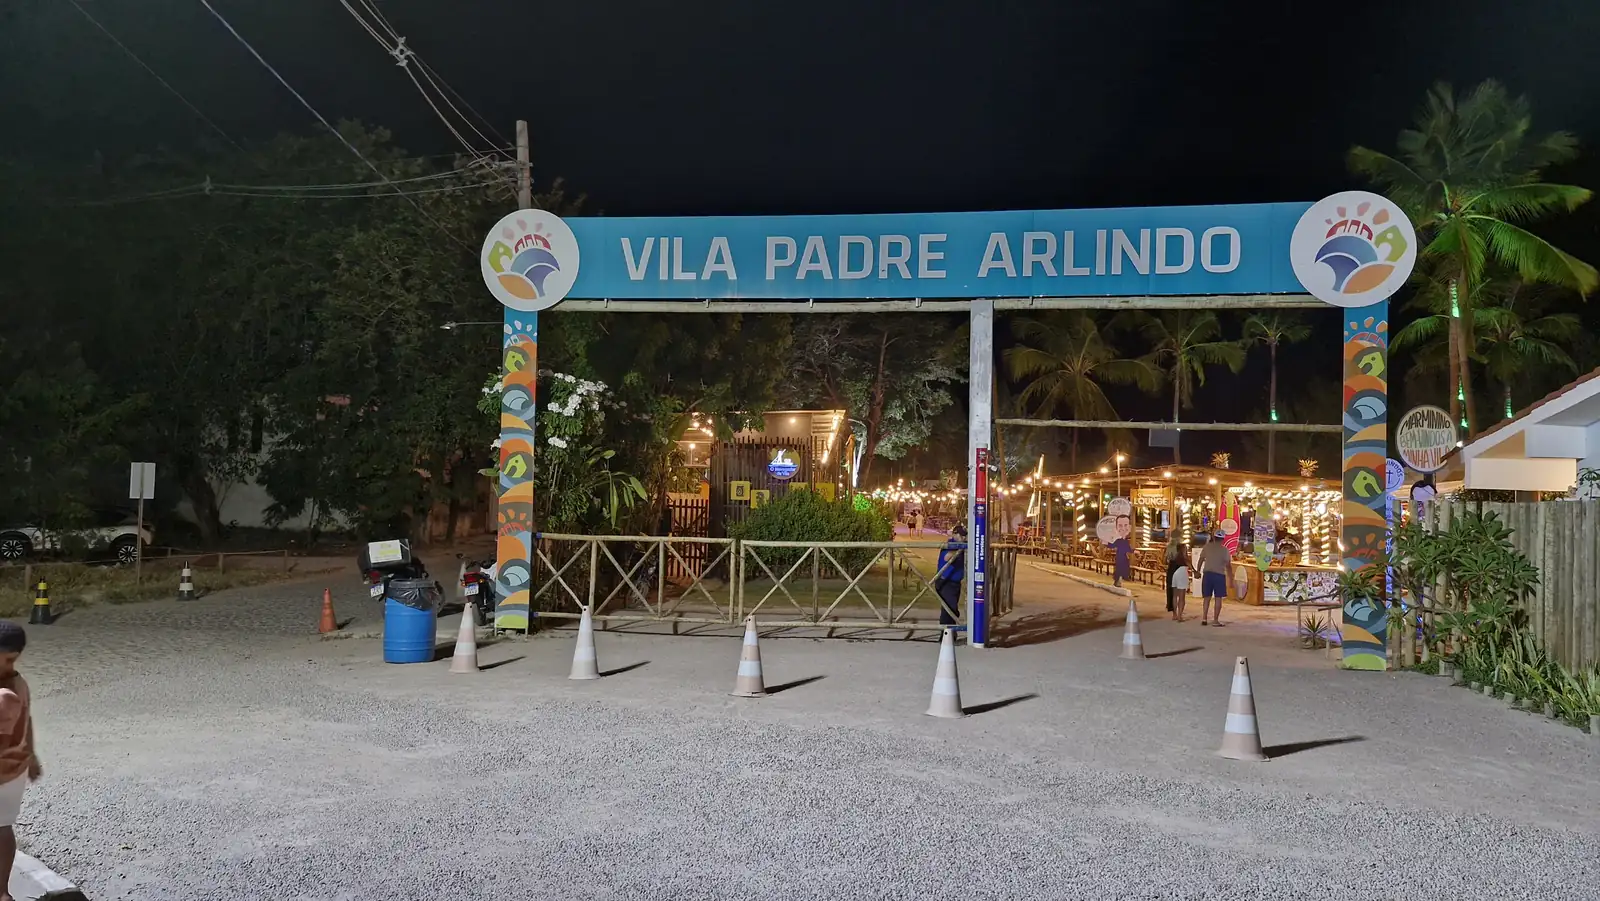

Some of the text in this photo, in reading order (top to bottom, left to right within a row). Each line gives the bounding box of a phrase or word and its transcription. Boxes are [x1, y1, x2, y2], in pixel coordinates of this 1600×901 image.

[620, 226, 1241, 281] VILA PADRE ARLINDO
[1402, 447, 1431, 469] MINHA
[1133, 497, 1168, 506] LOUNGE
